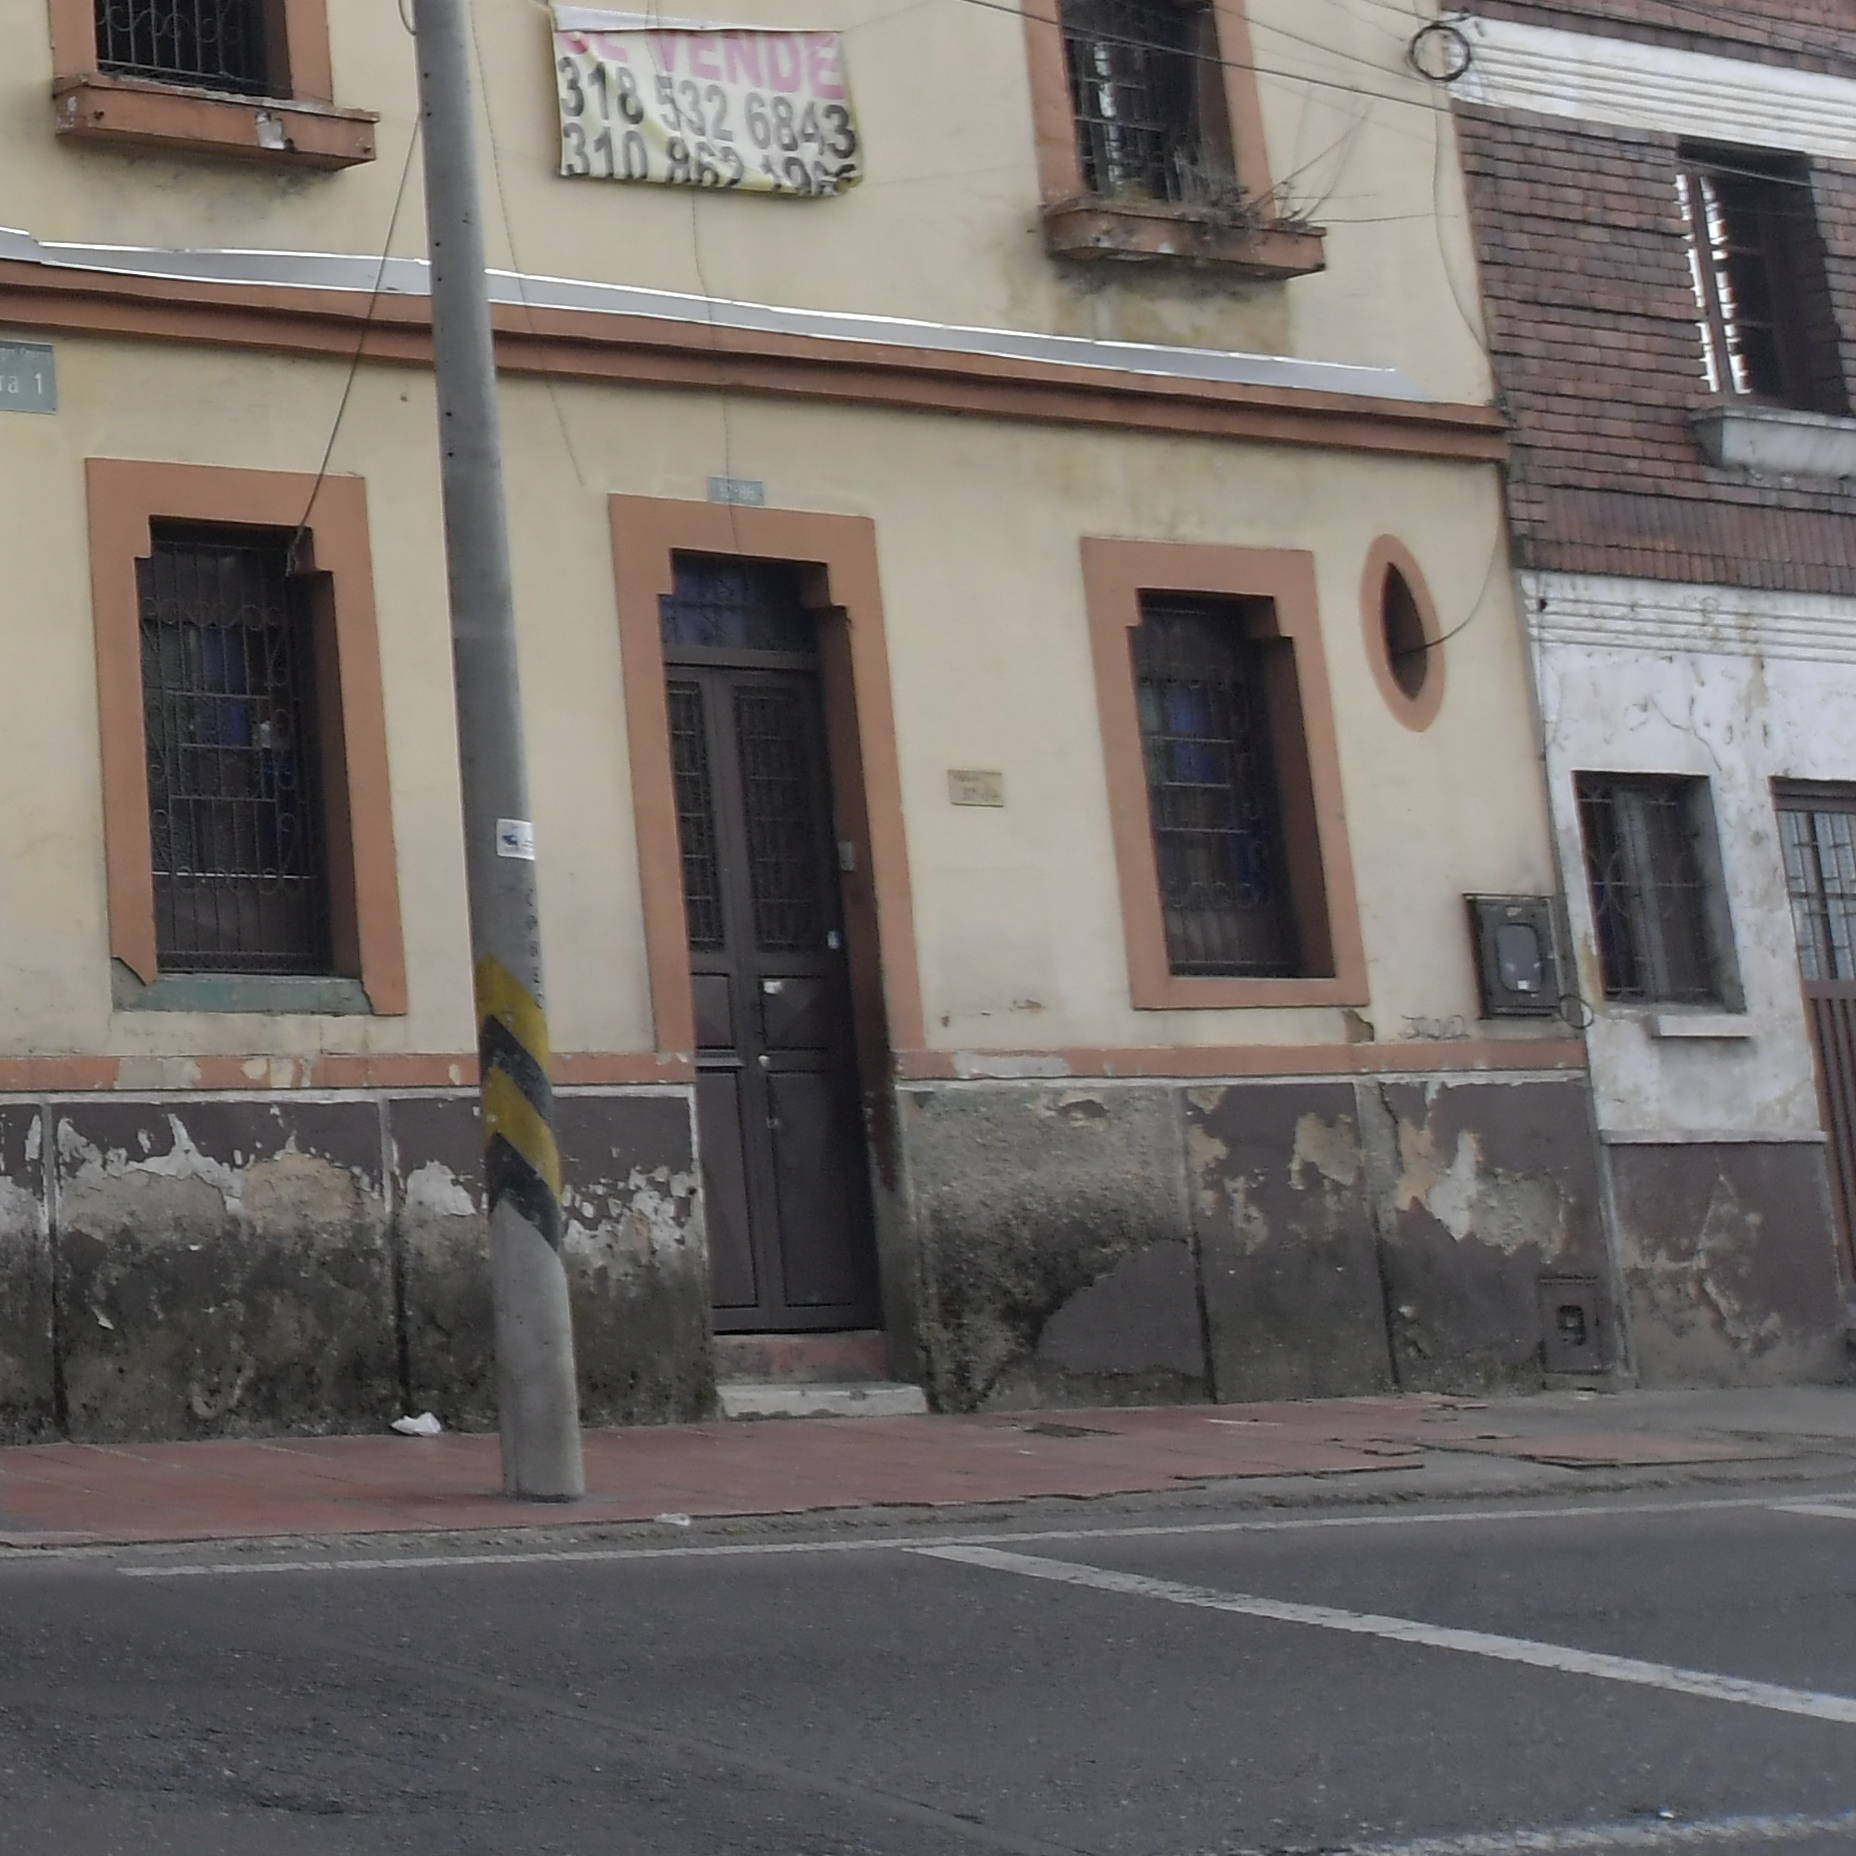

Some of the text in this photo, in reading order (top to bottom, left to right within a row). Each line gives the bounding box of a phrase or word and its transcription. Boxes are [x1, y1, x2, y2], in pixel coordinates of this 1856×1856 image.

[557, 56, 856, 159] 318 532 6843
[34, 372, 43, 394] 1
